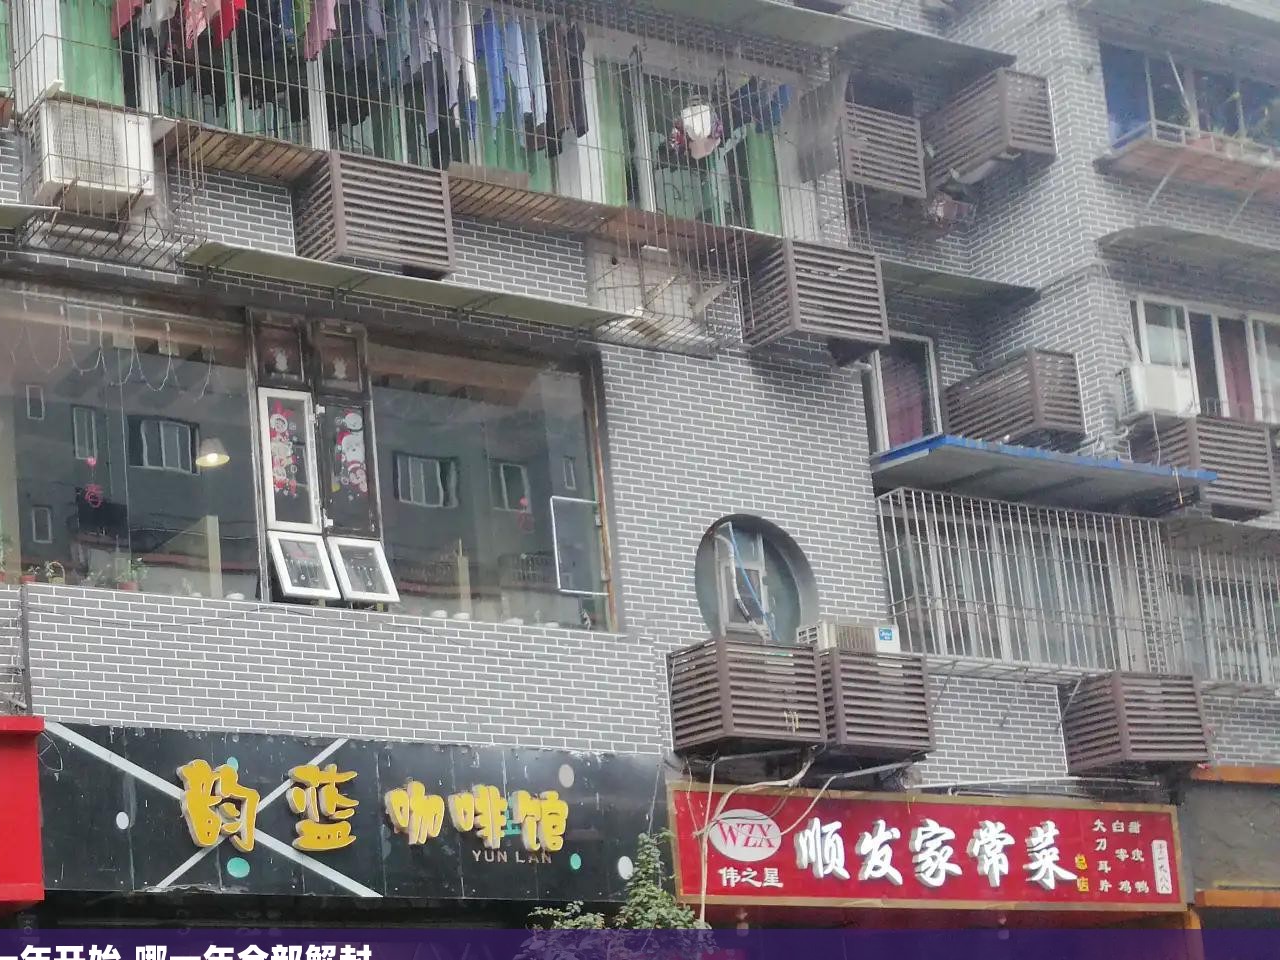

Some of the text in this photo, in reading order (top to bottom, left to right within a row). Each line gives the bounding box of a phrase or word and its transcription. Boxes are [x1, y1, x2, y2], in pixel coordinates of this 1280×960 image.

[177, 759, 569, 852] 韵蓝 咖啡馆
[717, 821, 776, 848] WZX
[472, 850, 552, 864] YUN LAN
[796, 816, 1079, 890] 顺发家常菜
[718, 866, 784, 888] 伟之星
